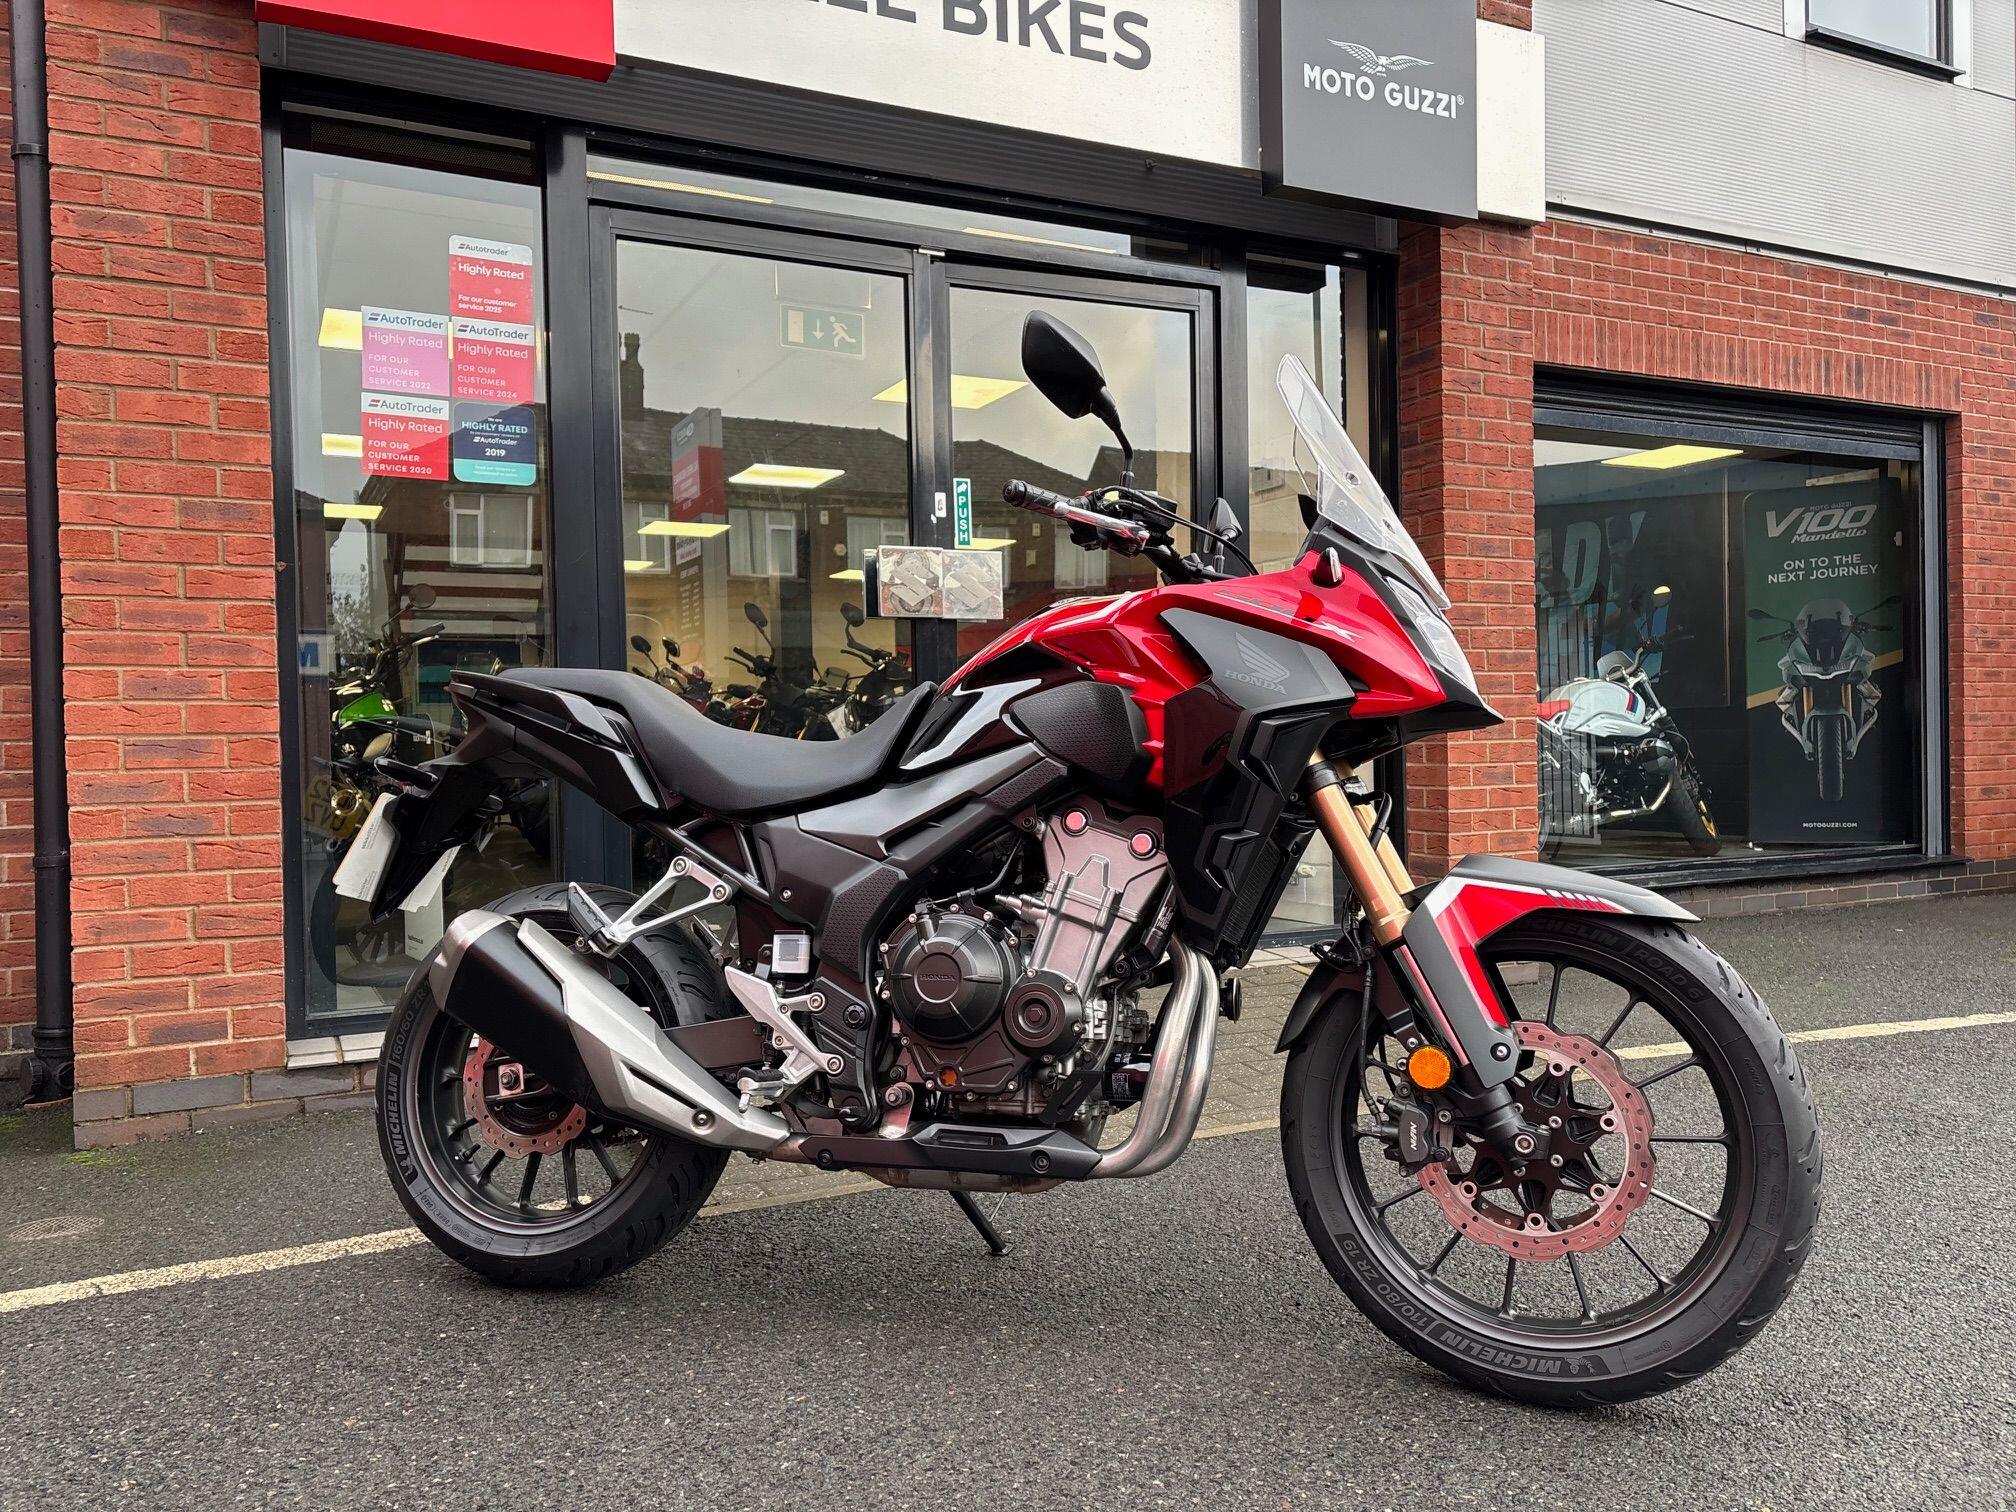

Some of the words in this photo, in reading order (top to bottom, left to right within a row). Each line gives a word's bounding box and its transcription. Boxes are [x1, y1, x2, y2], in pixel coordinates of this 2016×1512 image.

[943, 0, 1152, 70] BIKES
[1303, 62, 1375, 101] MOTO
[458, 262, 491, 277] Highly
[493, 267, 524, 280] Rated
[458, 302, 484, 311] service
[484, 298, 517, 308] customer
[381, 313, 444, 329] AutoTrader
[368, 331, 405, 346] Highly
[408, 336, 443, 349] Rated
[469, 325, 529, 340] AutoTrader
[368, 353, 387, 362] FOR
[389, 355, 409, 364] OUR
[457, 342, 493, 357] Highly
[495, 347, 528, 359] Rated
[368, 365, 420, 377] CUSTOMER
[457, 364, 475, 372] FOR
[477, 366, 496, 374] OUR
[368, 376, 408, 387] SERVICE
[409, 380, 431, 390] 2022
[457, 375, 506, 386] CUSTOMER
[457, 386, 494, 396] SERVICE
[496, 390, 517, 398] 2024
[381, 400, 444, 414] AutoTrader
[368, 418, 406, 432] Highly
[408, 421, 443, 434] Rated
[461, 421, 497, 431] HIGHLY
[498, 425, 528, 434] RATED
[368, 440, 387, 448] FOR
[389, 441, 410, 449] OUR
[480, 436, 518, 446] AutoTrader
[367, 451, 420, 462] CUSTOMER
[484, 448, 506, 457] 2019
[367, 462, 408, 472] SERVICE
[409, 465, 432, 475] 2020
[1810, 503, 1830, 511] MOTO
[958, 495, 968, 542] PUSH
[1766, 504, 1878, 538] V100
[1791, 528, 1867, 544] Mandello
[1783, 559, 1805, 571] ON
[1809, 556, 1829, 568] TO
[1833, 553, 1862, 566] THE
[1768, 571, 1805, 584] NEXT
[1809, 563, 1878, 580] JOURNEY
[1223, 670, 1288, 696] HONDA
[1633, 948, 1688, 986] ROAD
[920, 973, 957, 981] HONDA
[392, 1010, 414, 1061] 160/60
[388, 1072, 407, 1155] MICHELIN
[1343, 1239, 1360, 1258] 19
[1356, 1259, 1379, 1281] ZR
[1377, 1283, 1428, 1327] 110/80
[1438, 1329, 1563, 1375] MICHELIN
